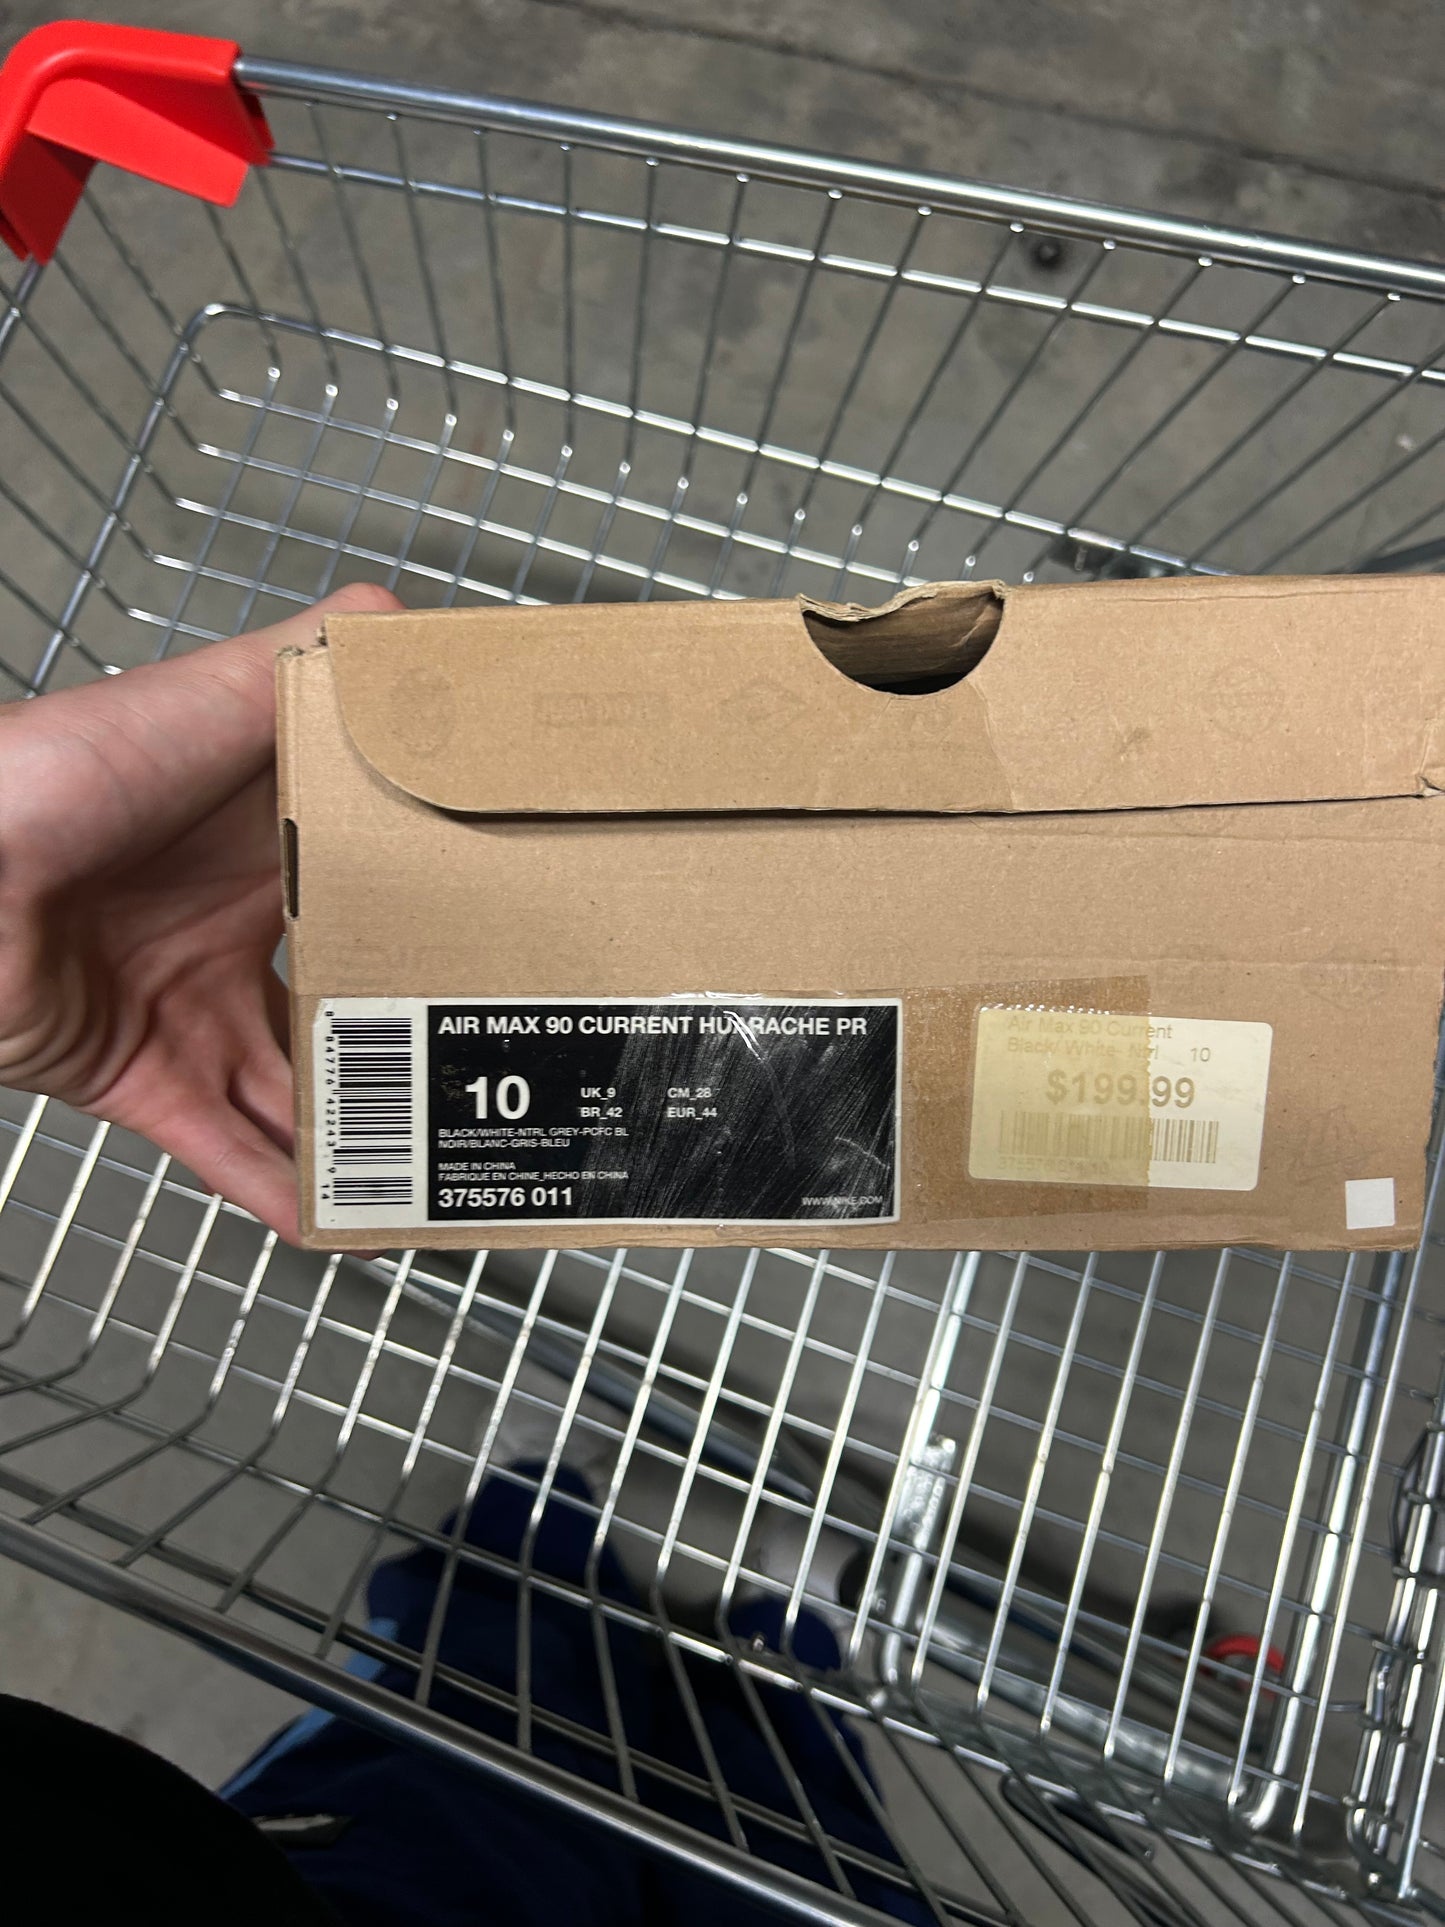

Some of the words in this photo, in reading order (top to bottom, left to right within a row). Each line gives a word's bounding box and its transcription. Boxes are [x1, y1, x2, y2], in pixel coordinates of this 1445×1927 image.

[438, 1016, 480, 1035] AIR
[486, 1016, 541, 1034] MAX
[545, 1016, 573, 1034] 90
[578, 1016, 693, 1034] CURRENT
[699, 1016, 830, 1036] HUARACHE
[836, 1017, 867, 1035] PR
[1007, 1016, 1030, 1034] Air
[1038, 1017, 1074, 1035] Max
[1079, 1017, 1101, 1036] 90
[1104, 1019, 1173, 1040] Current
[1190, 1047, 1212, 1063] 10
[580, 1087, 617, 1101] UK_9
[667, 1087, 713, 1101] CM_28
[1046, 1069, 1195, 1109] $199.99
[465, 1075, 531, 1120] 10
[580, 1106, 623, 1120] BR_42
[666, 1107, 718, 1121] EUR_44
[614, 1126, 630, 1137] BL
[438, 1138, 571, 1149] NOIR/BLANC-GRIS-BLEU
[438, 1162, 469, 1171] MADE
[470, 1162, 482, 1171] IN
[482, 1161, 517, 1171] CHINA
[438, 1172, 491, 1182] FABRIQUE
[491, 1172, 507, 1182] EN
[580, 1171, 596, 1180] EN
[596, 1171, 630, 1180] CHINA
[320, 1184, 331, 1200] 14
[437, 1187, 526, 1208] 375576
[531, 1186, 573, 1207] 011
